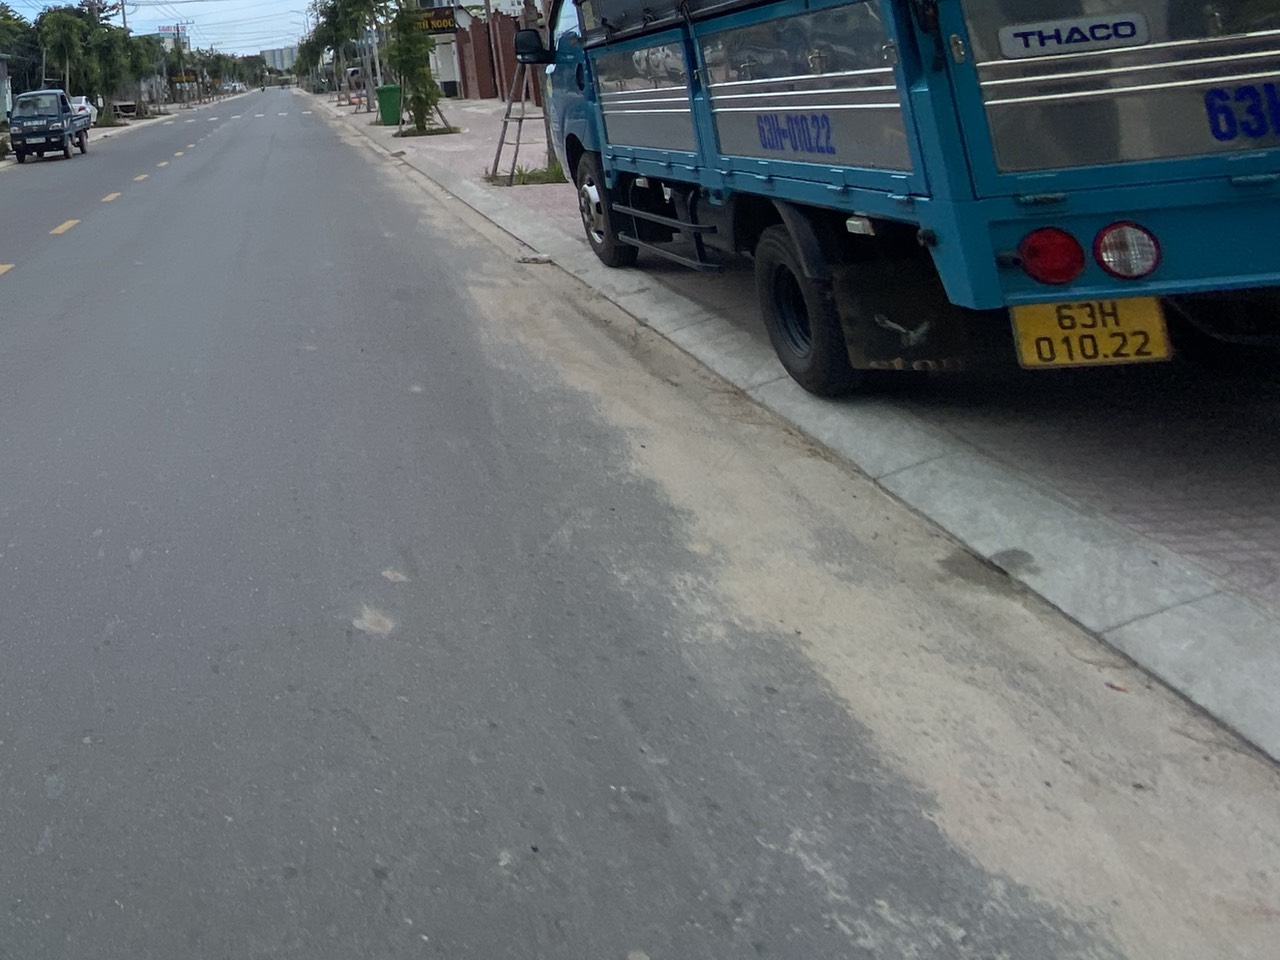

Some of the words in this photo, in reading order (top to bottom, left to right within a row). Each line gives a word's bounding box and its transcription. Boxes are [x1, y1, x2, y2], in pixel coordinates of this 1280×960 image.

[1013, 21, 1136, 48] THACO
[1055, 301, 1120, 330] 63H
[1035, 331, 1152, 362] 010.22
